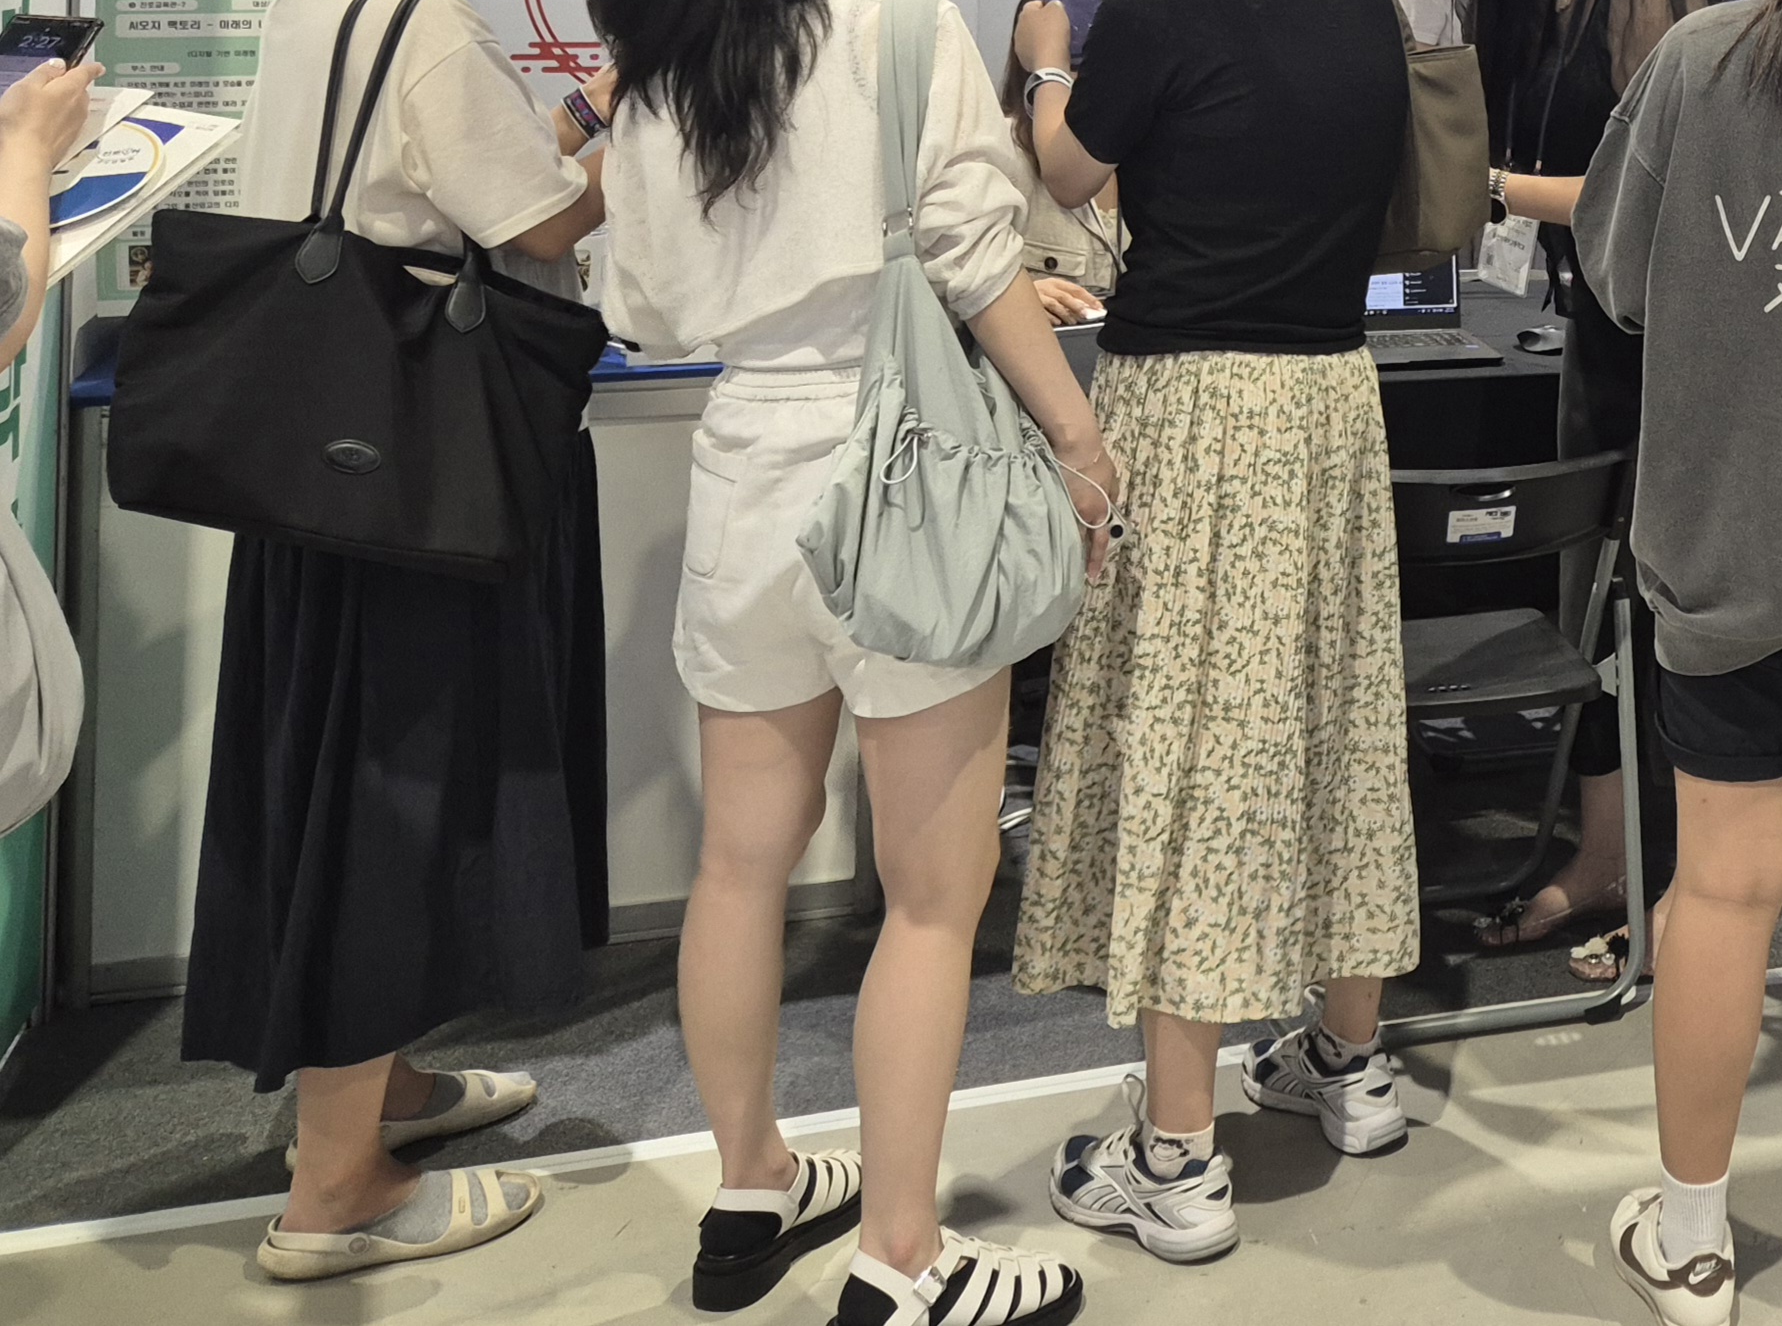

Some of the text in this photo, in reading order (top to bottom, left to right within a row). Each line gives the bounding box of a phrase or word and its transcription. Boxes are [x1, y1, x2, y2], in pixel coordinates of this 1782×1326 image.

[168, 20, 201, 30] 팩토리
[220, 20, 252, 29] 미래의
[17, 35, 62, 49] 2:27
